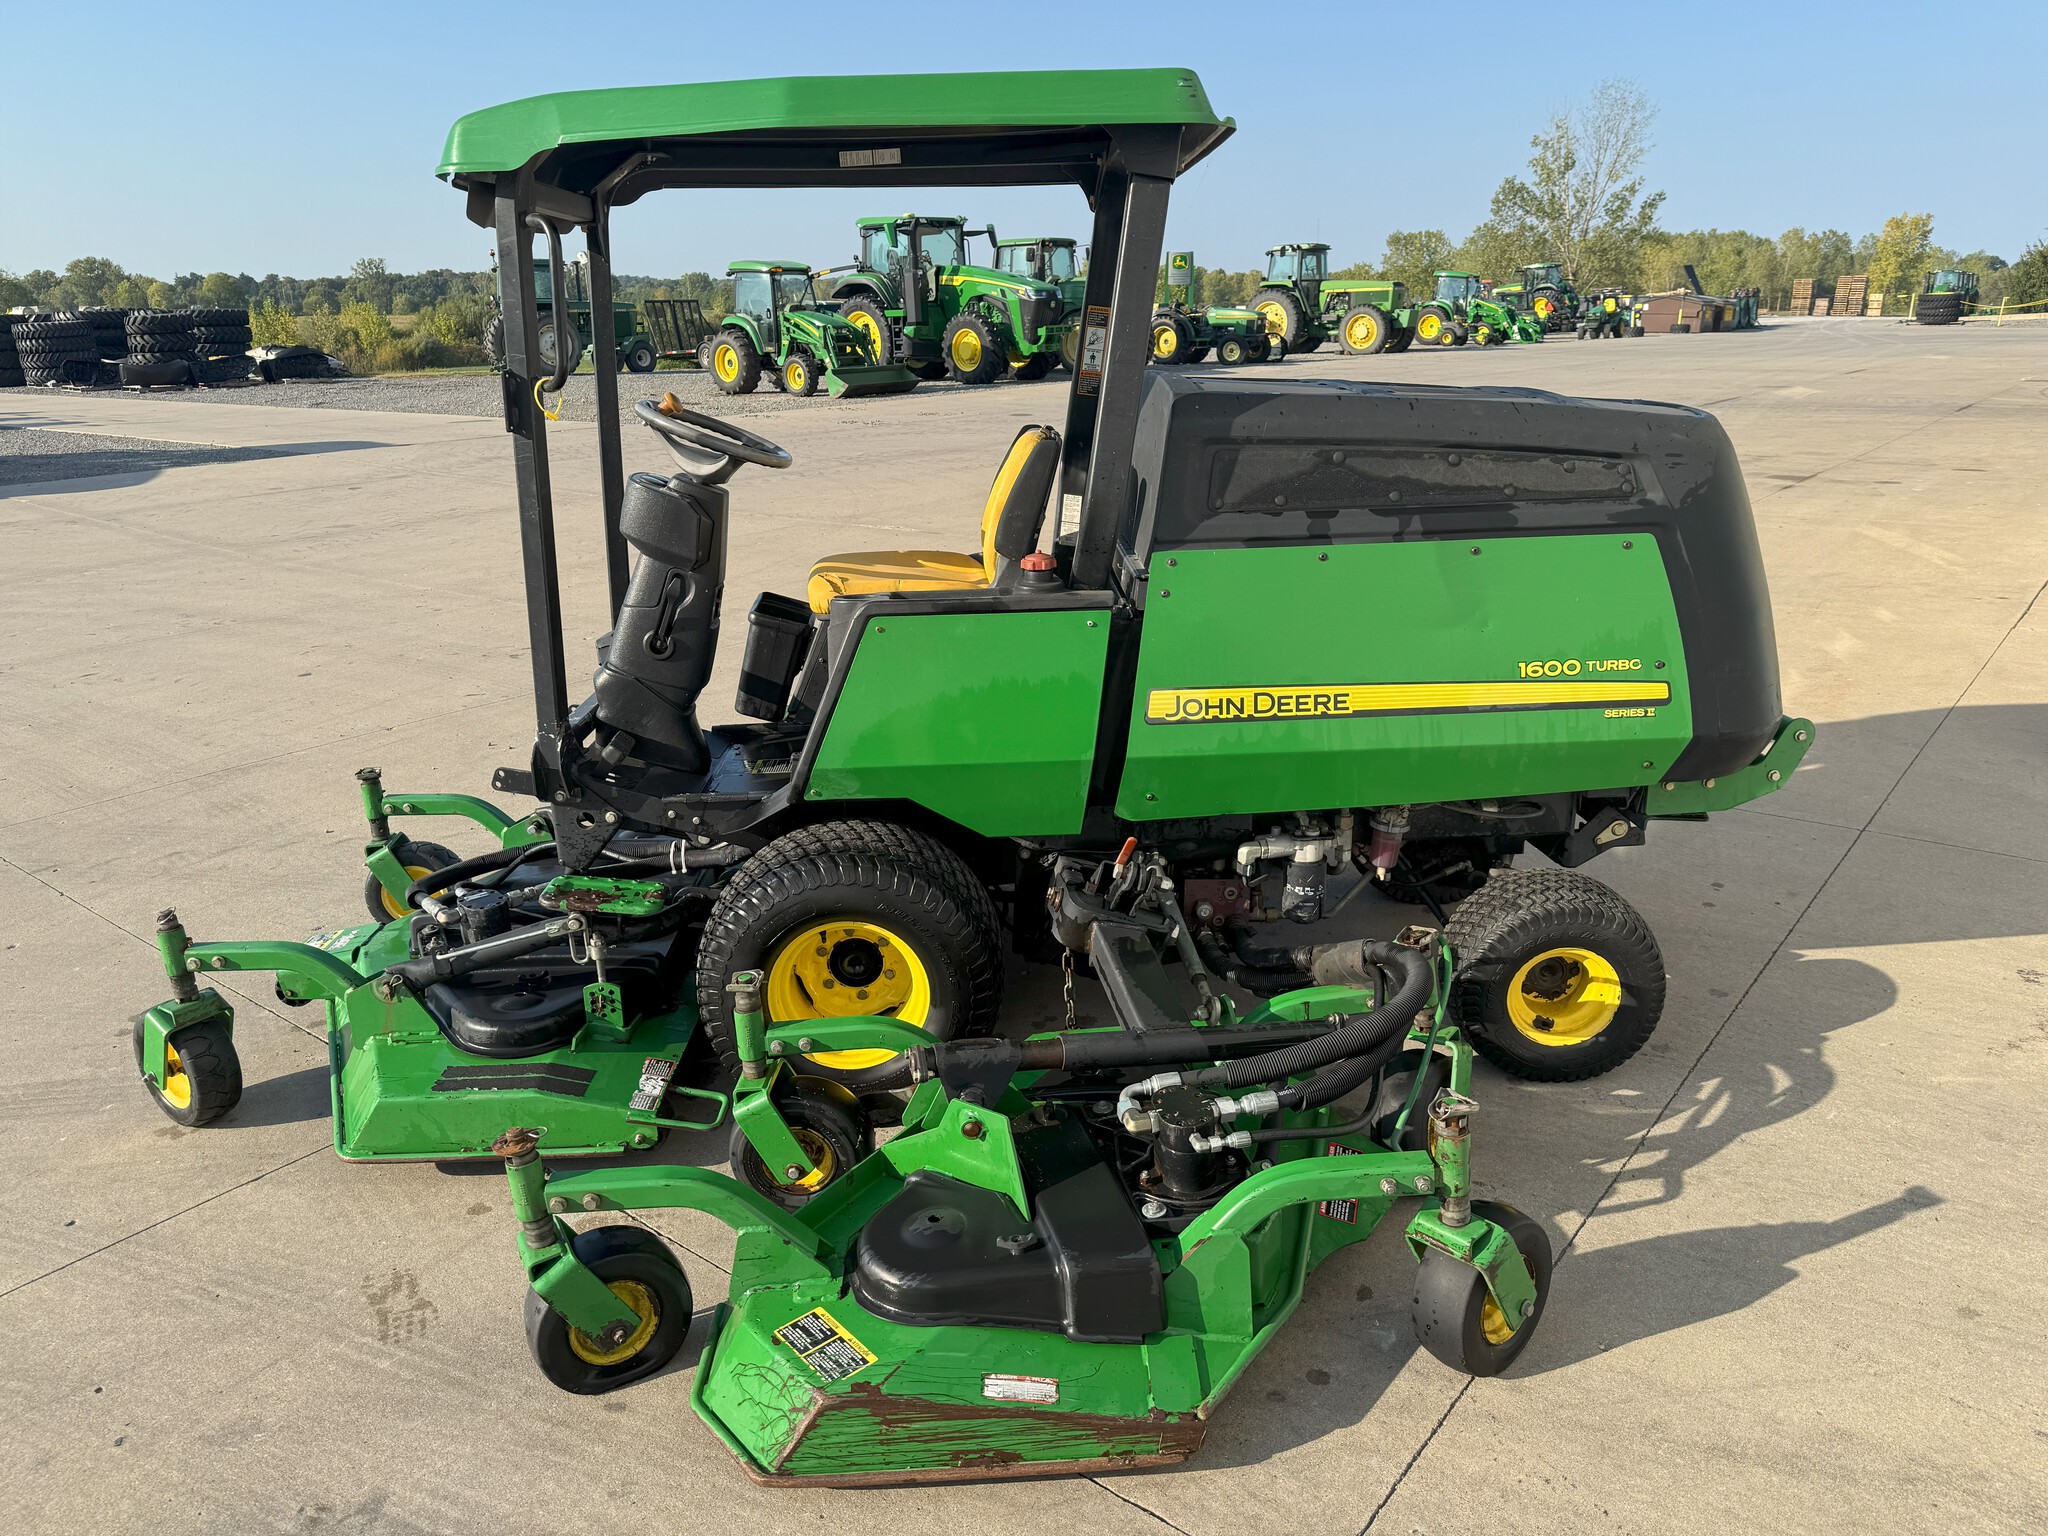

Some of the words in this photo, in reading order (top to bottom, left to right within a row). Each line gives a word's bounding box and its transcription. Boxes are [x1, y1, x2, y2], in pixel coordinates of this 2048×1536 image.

[1518, 658, 1582, 678] 1600
[1585, 658, 1643, 672] TURBO
[1165, 694, 1245, 718] JOHN
[1252, 691, 1350, 714] DEERE
[1603, 708, 1646, 718] SERIES
